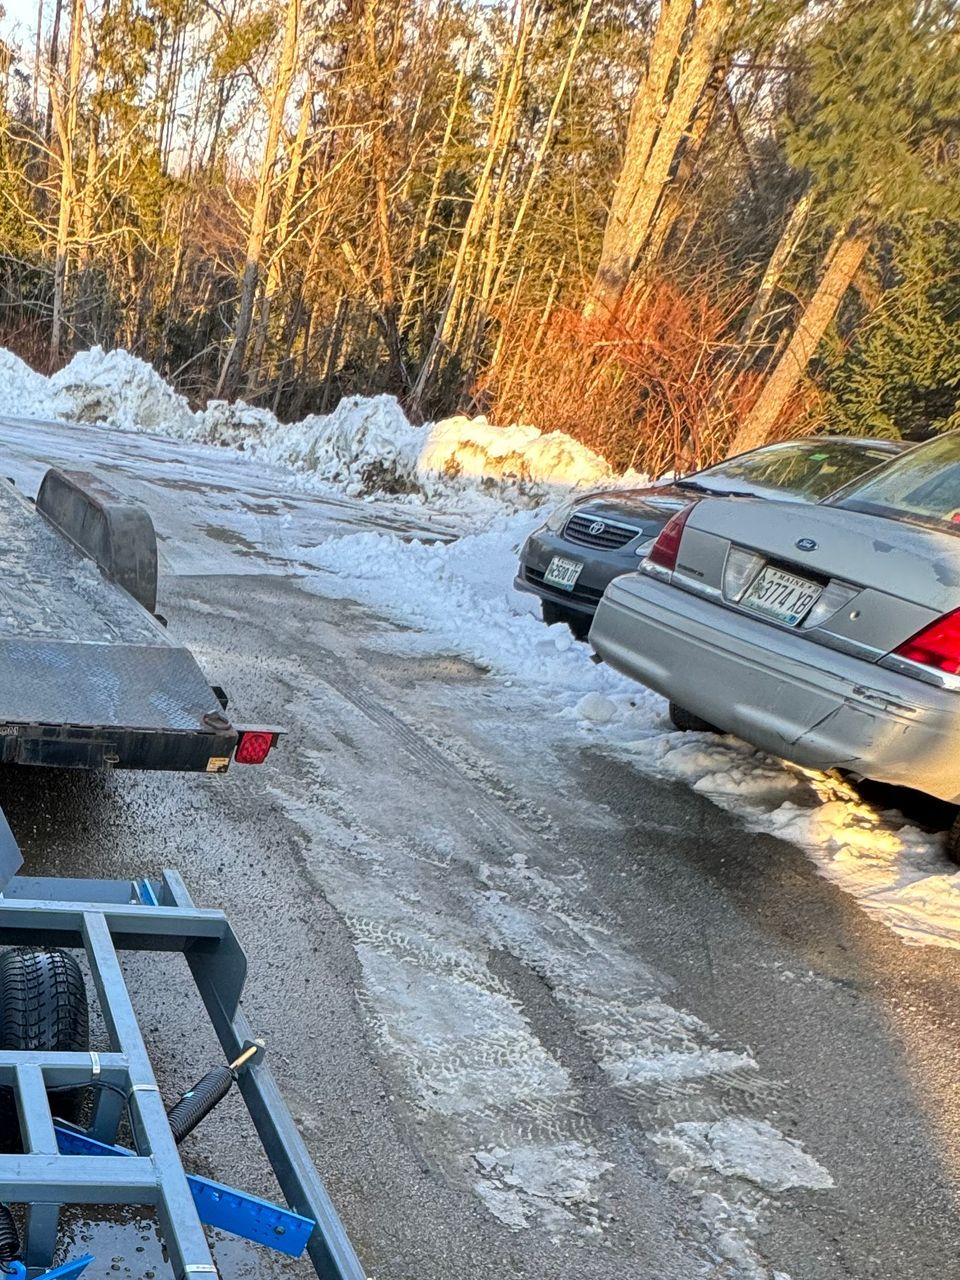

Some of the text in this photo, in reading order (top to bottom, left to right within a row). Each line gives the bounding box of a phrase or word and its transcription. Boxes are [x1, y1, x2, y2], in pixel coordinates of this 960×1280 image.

[777, 574, 807, 589] MAINE
[758, 580, 814, 615] 3774 XB
